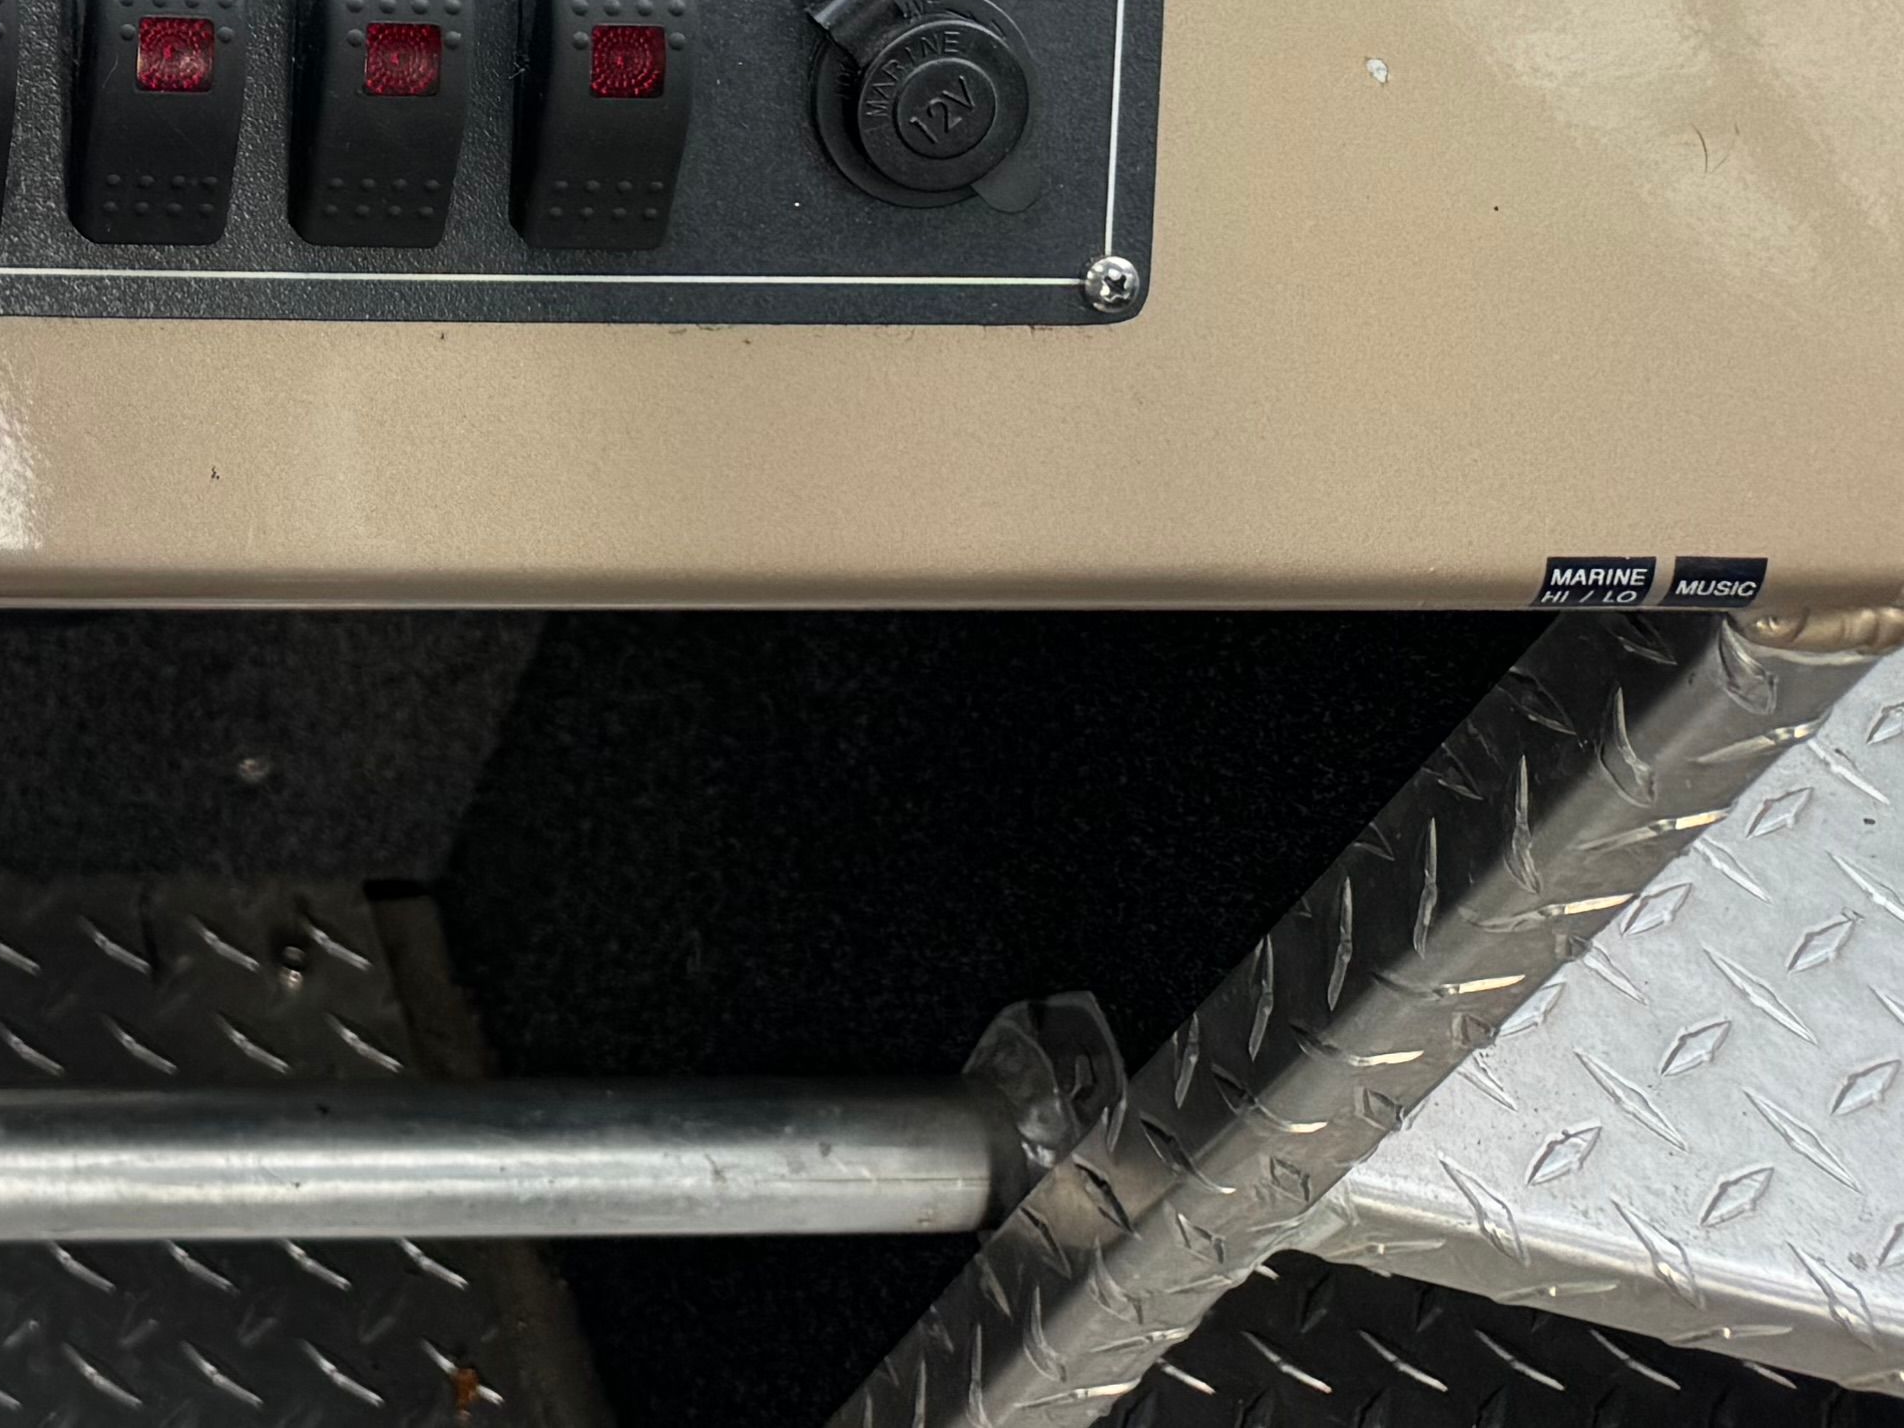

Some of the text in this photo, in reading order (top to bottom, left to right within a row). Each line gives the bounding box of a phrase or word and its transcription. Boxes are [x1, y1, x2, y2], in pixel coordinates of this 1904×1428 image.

[1550, 568, 1648, 586] MARINE
[1541, 590, 1569, 603] HI
[1602, 590, 1638, 603] LO
[1675, 580, 1757, 597] MUSIC
